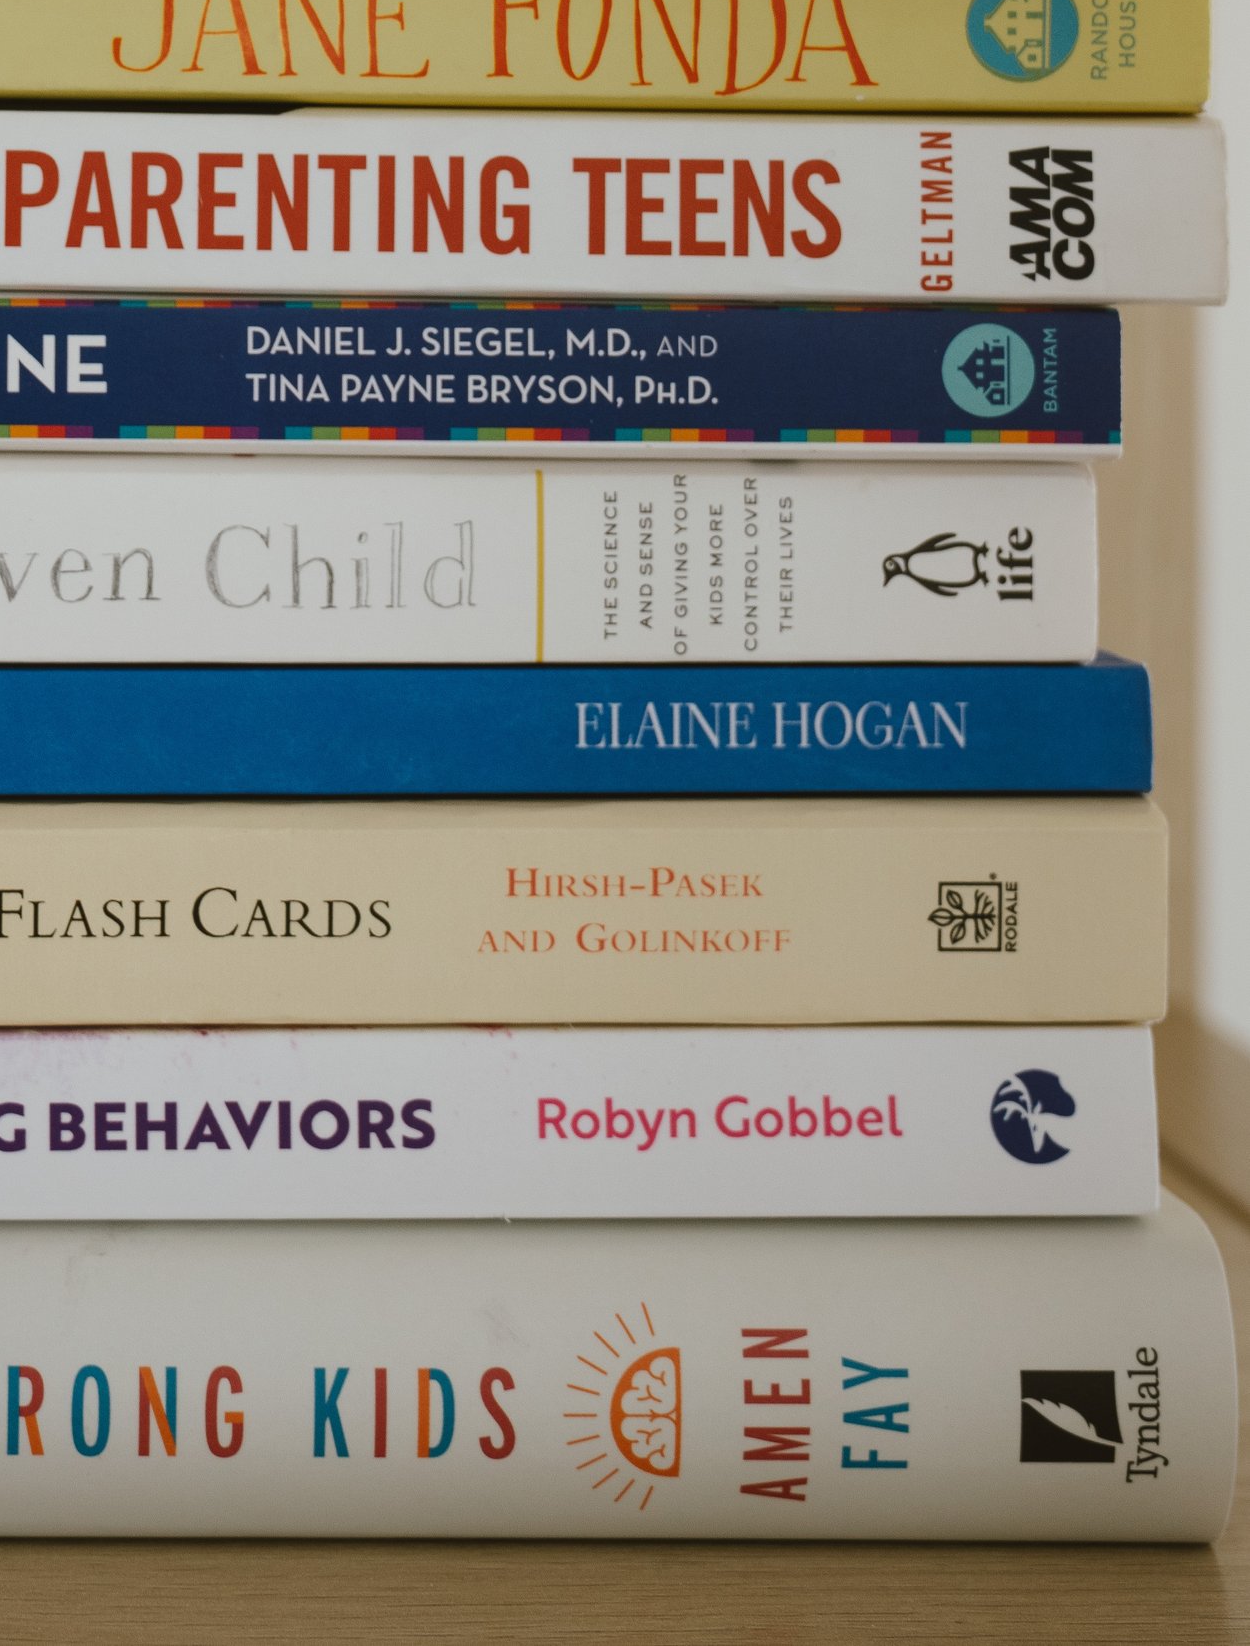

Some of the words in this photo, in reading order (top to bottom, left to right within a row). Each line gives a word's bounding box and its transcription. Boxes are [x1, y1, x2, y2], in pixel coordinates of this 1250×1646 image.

[3, 149, 531, 256] PARENTING
[572, 157, 843, 260] TEENS
[919, 131, 954, 293] GELTMAN
[246, 325, 377, 356] DANIEL
[385, 326, 412, 356] J.
[421, 326, 556, 360] SIEGEL,
[566, 327, 647, 361] M.D.,
[656, 334, 718, 358] AND
[1042, 327, 1059, 413] BANTAM
[245, 372, 330, 403] TINA
[341, 373, 456, 404] PAYNE
[467, 374, 624, 408] BRYSON,
[638, 502, 654, 576] SENSE
[672, 474, 689, 535] YOUR
[708, 504, 724, 567] MORE
[743, 477, 759, 538] OVER
[778, 496, 794, 560] LIVES
[205, 519, 477, 611] Child
[603, 491, 619, 590] SCIENCE
[996, 527, 1034, 601] life
[639, 583, 654, 630] AND
[673, 541, 689, 619] GIVING
[708, 575, 724, 626] KIDS
[743, 545, 759, 653] CONTROL
[778, 567, 794, 633] THEIR
[603, 597, 618, 640] THE
[673, 626, 689, 657] OF
[575, 701, 757, 749] ELAINE
[773, 701, 966, 749] HOGAN
[1005, 881, 1019, 953] RODALE
[49, 1098, 436, 1152] BEHAVIORS
[537, 1097, 697, 1152] Robyn
[714, 1094, 904, 1139] Gobbel
[312, 1366, 517, 1461] KIDS
[738, 1328, 811, 1503] AMEN
[840, 1357, 910, 1470] FAY
[1124, 1346, 1169, 1485] Tyndale
